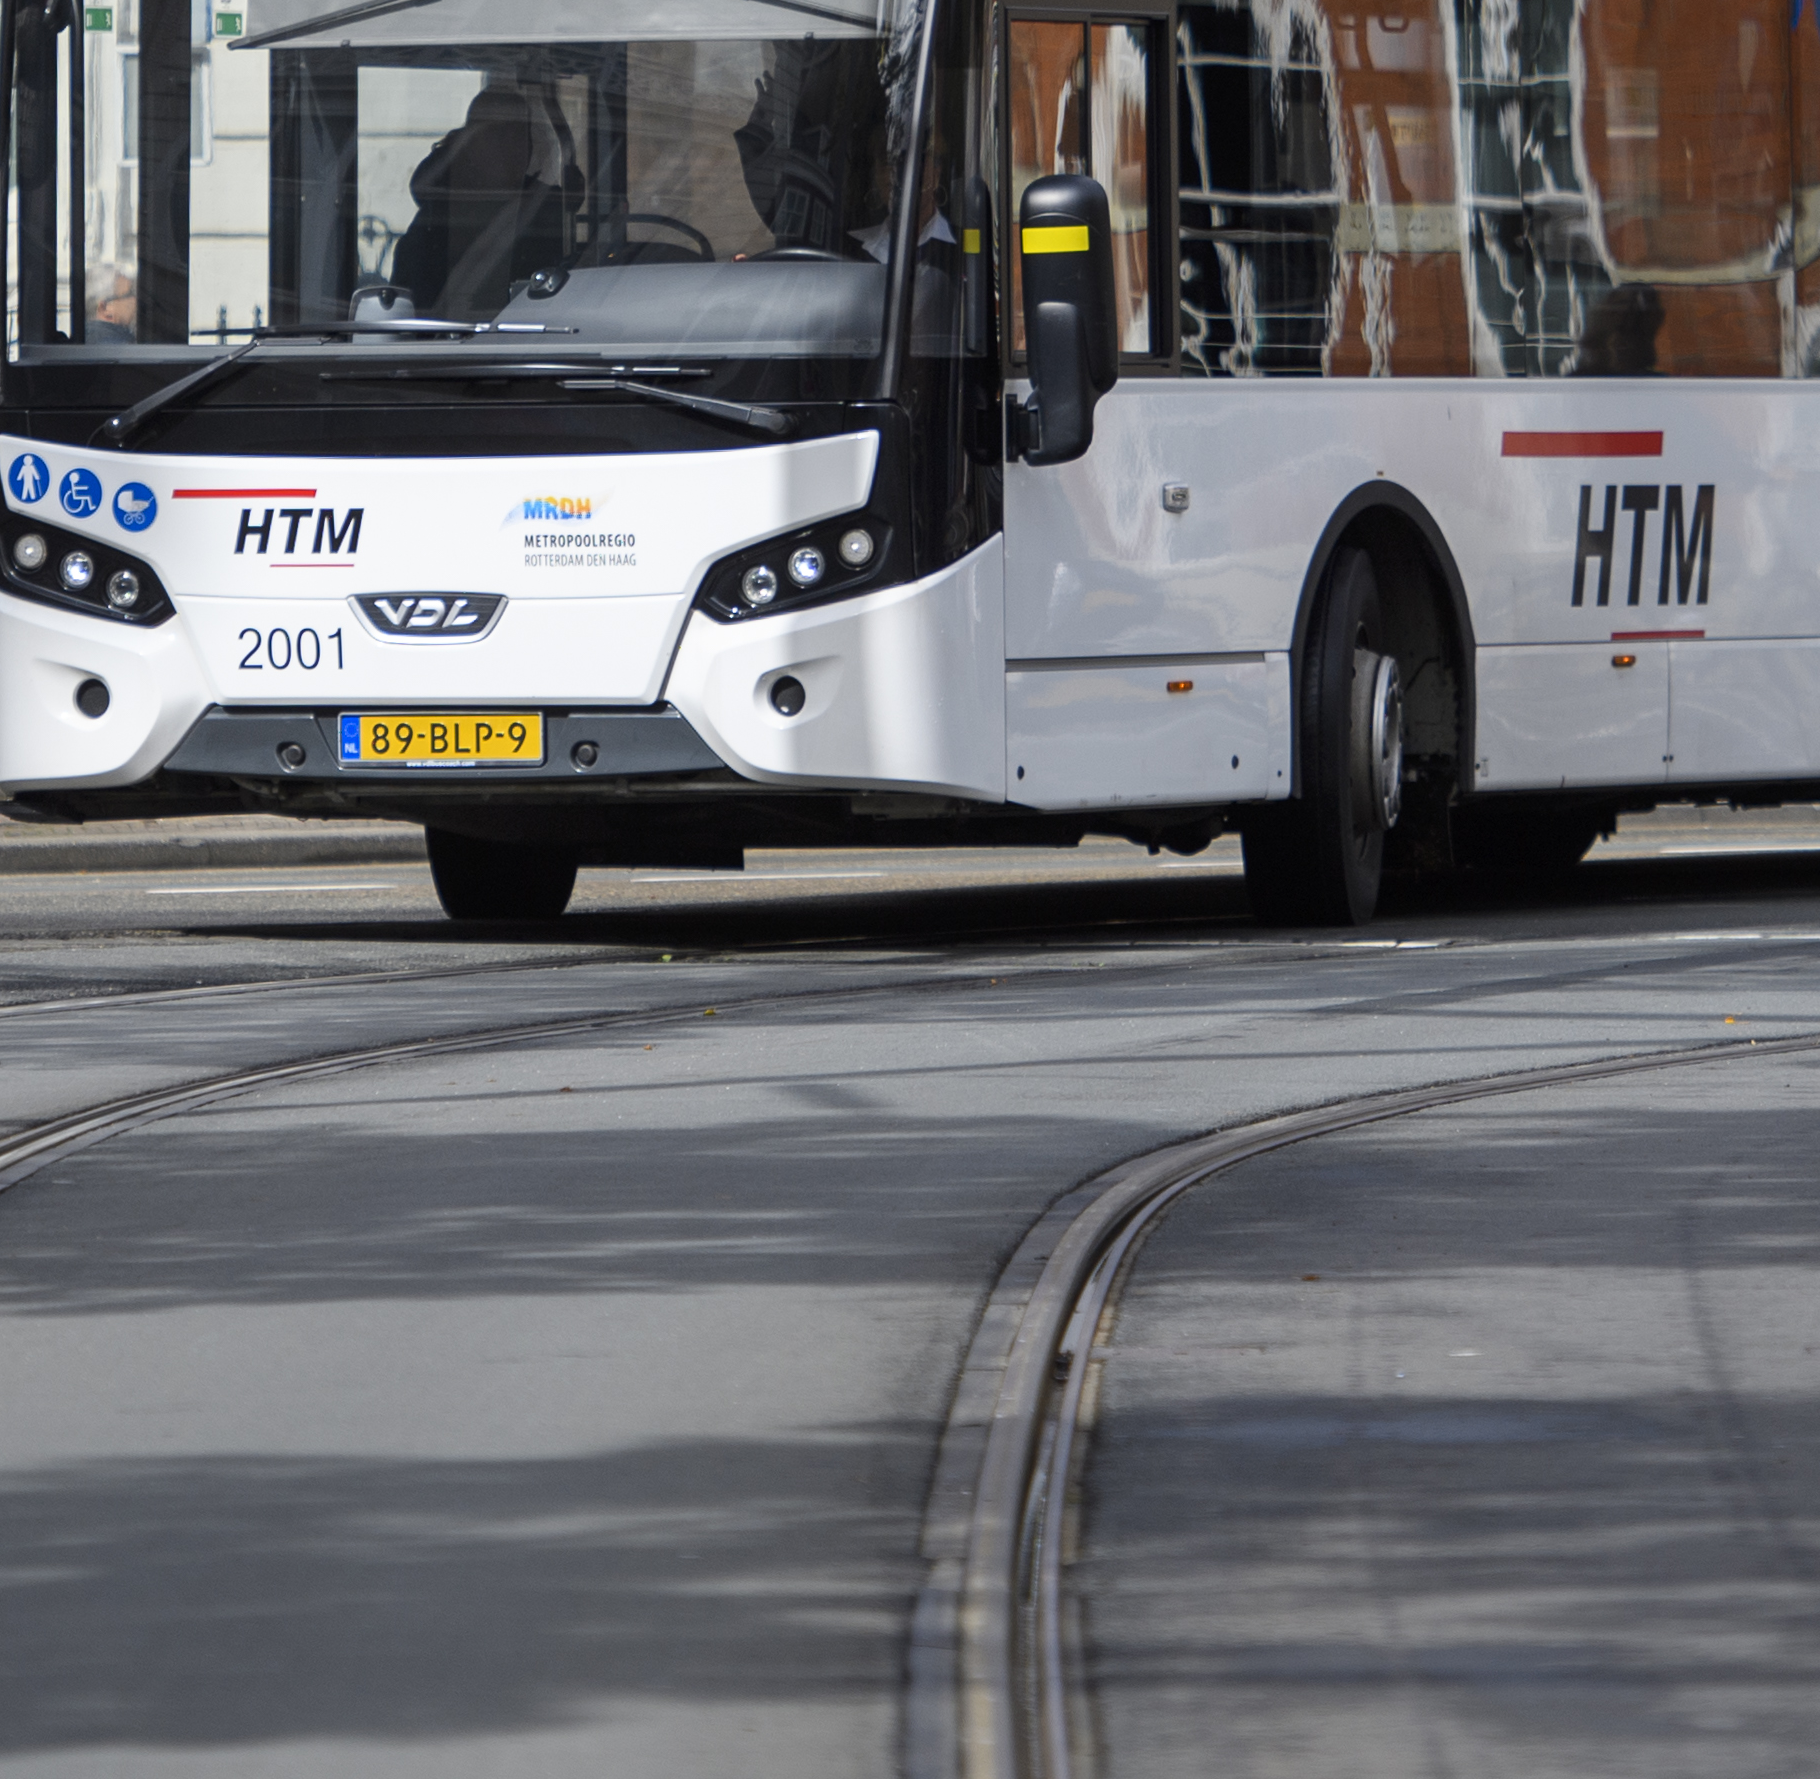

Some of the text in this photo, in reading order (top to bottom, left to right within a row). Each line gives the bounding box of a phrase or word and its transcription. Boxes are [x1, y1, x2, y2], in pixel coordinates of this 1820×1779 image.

[523, 496, 592, 520] MRDH
[234, 508, 364, 554] HTM
[524, 534, 636, 548] METROPOOLREGIO
[1571, 484, 1715, 607] HTM
[524, 553, 637, 567] ROTTERDAM DEN HAAG
[374, 597, 478, 629] VDL
[238, 627, 344, 670] 2001
[344, 743, 358, 753] NL
[371, 722, 527, 754] 89-BLP-9
